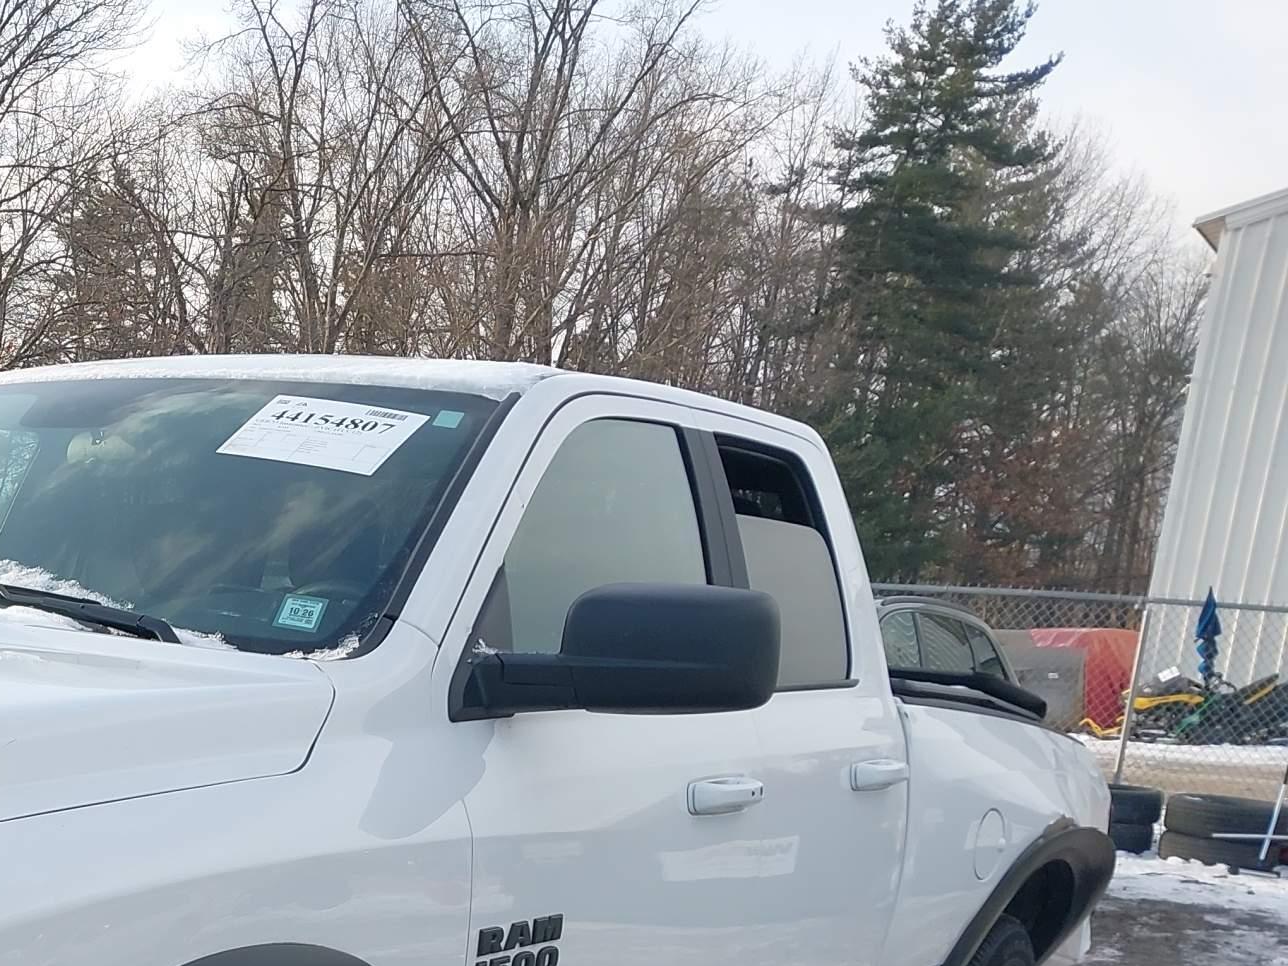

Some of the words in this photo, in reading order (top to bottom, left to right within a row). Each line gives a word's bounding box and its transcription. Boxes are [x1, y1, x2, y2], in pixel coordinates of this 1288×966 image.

[272, 409, 396, 434] 44154807
[289, 607, 300, 615] 10
[302, 608, 314, 617] 26
[476, 913, 564, 958] RAM
